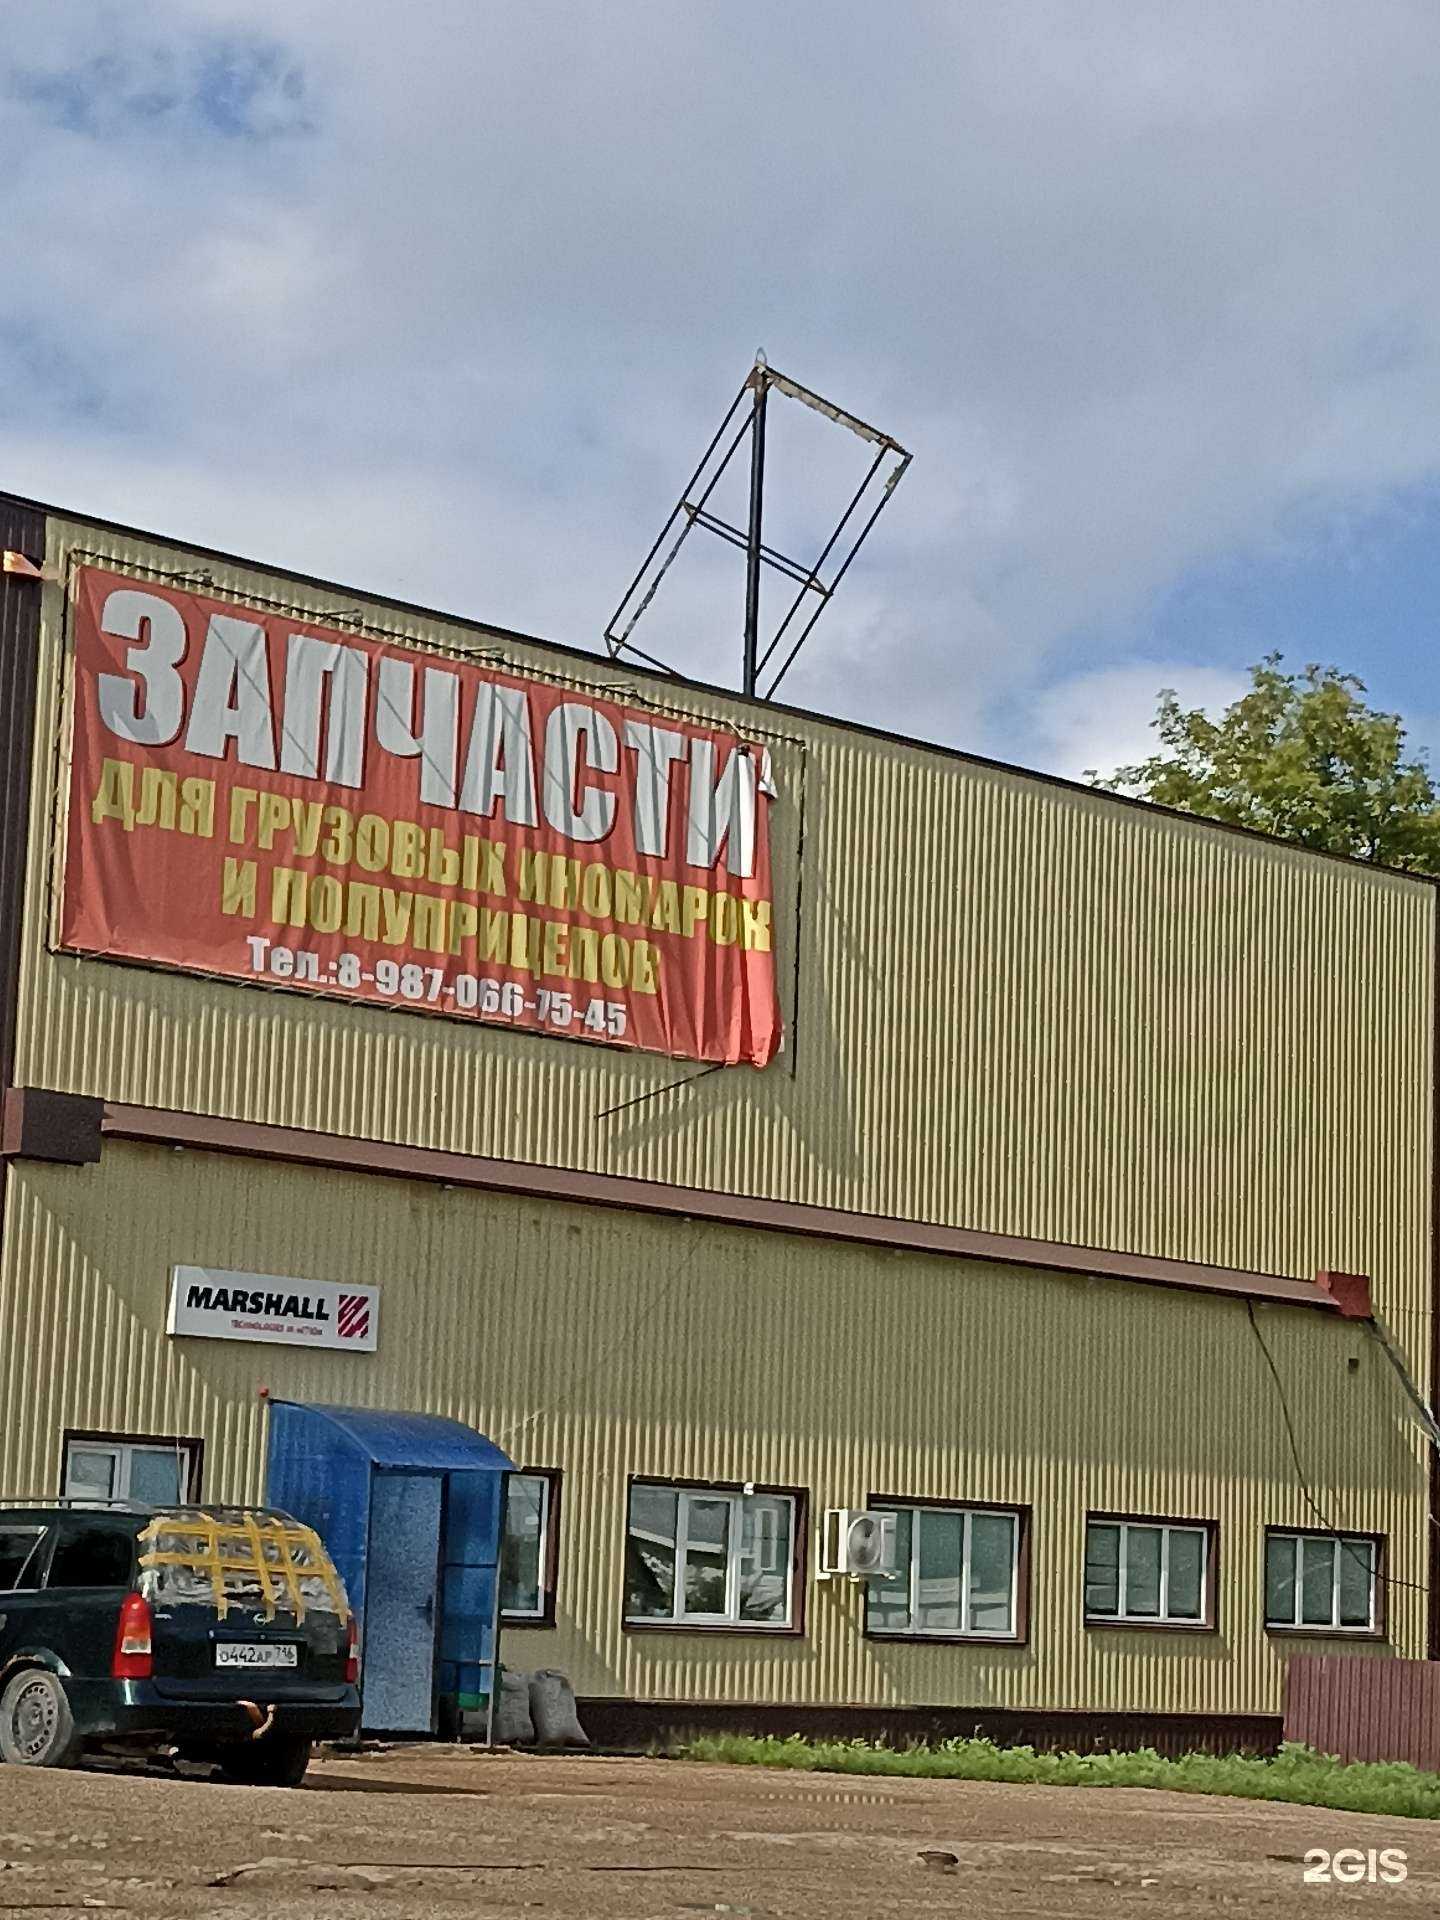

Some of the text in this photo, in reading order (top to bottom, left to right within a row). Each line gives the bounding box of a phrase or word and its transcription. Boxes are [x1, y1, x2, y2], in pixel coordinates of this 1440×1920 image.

[100, 589, 758, 880] ЗАПЧАСТИ
[92, 757, 772, 952] ДЛЯ ГРУЗОВЫХ ИНОМАРОК
[221, 856, 661, 995] И ПОЛУПРИЦЕПОВ
[187, 1285, 329, 1320] MARSHALL
